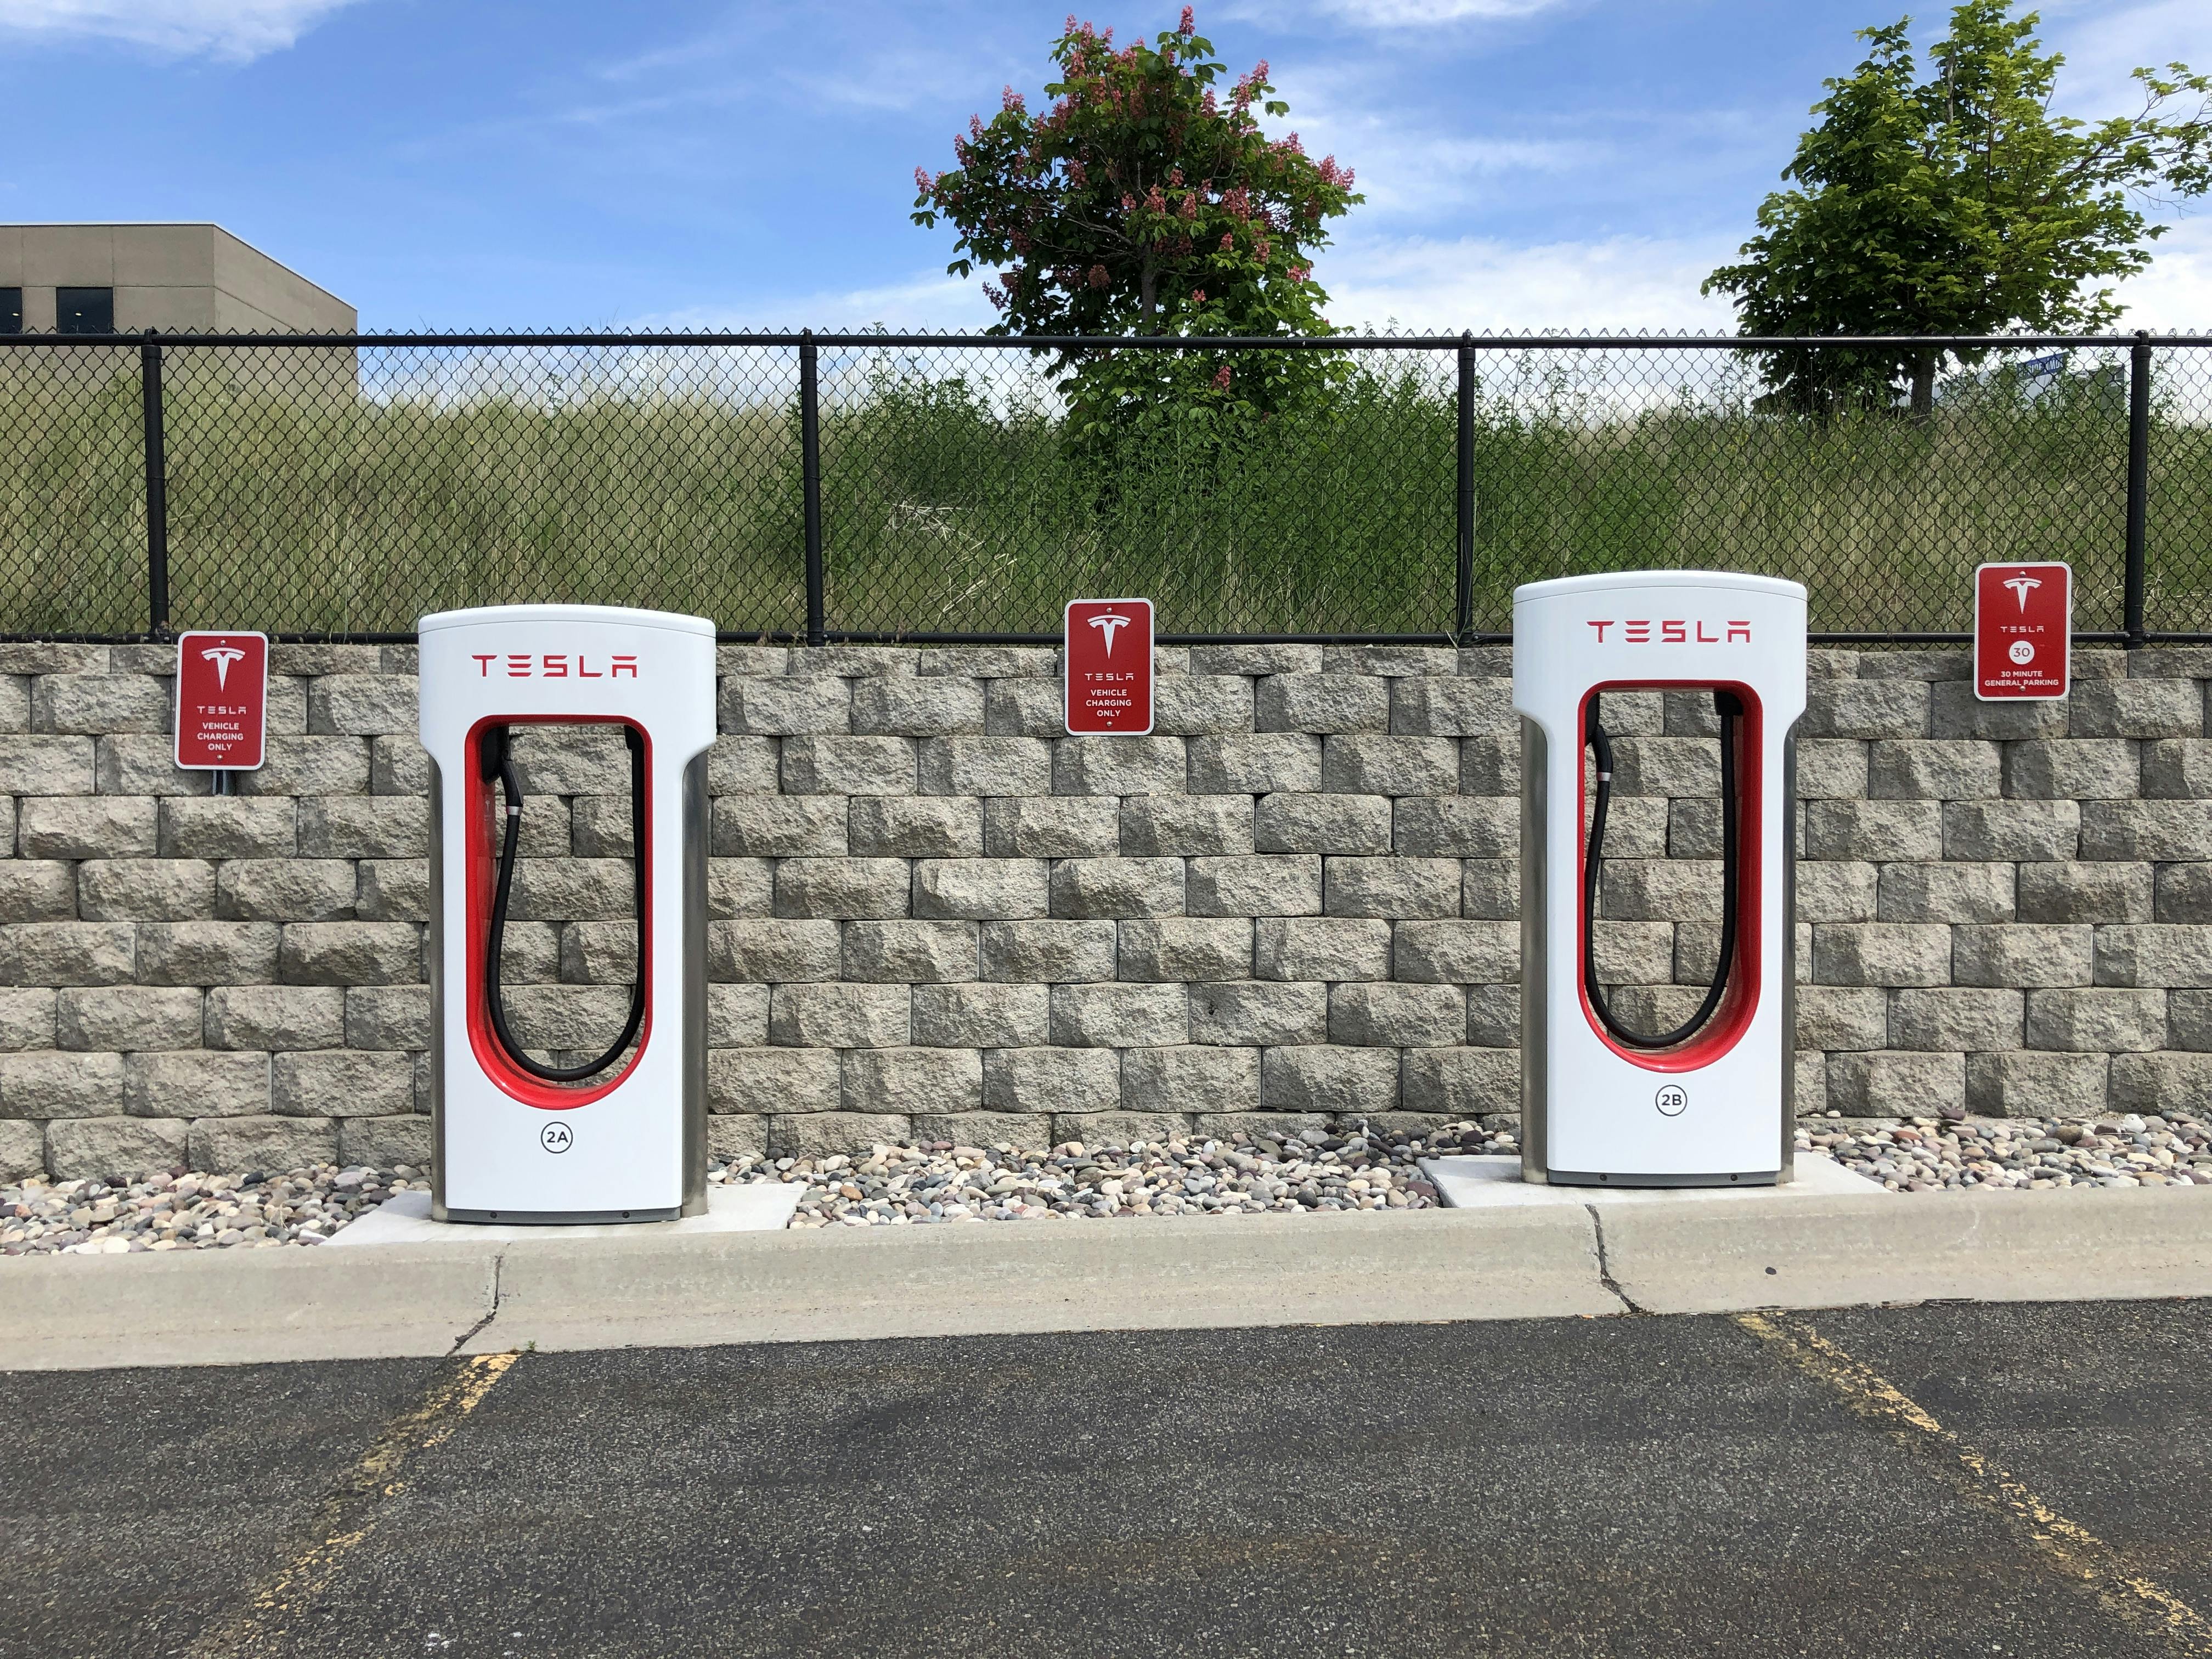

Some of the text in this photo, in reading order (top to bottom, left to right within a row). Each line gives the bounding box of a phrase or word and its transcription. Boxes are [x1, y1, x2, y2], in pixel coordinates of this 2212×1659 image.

[1587, 620, 1751, 643] TESLA
[2013, 648, 2030, 657] 30
[472, 654, 637, 678] TESLA
[1085, 673, 1134, 681] TESLA
[197, 706, 246, 714] TESLA
[202, 722, 239, 730] VEHICLE
[197, 732, 244, 741] CHARGING
[1661, 1094, 1682, 1105] 2B
[547, 1131, 568, 1143] 2A
